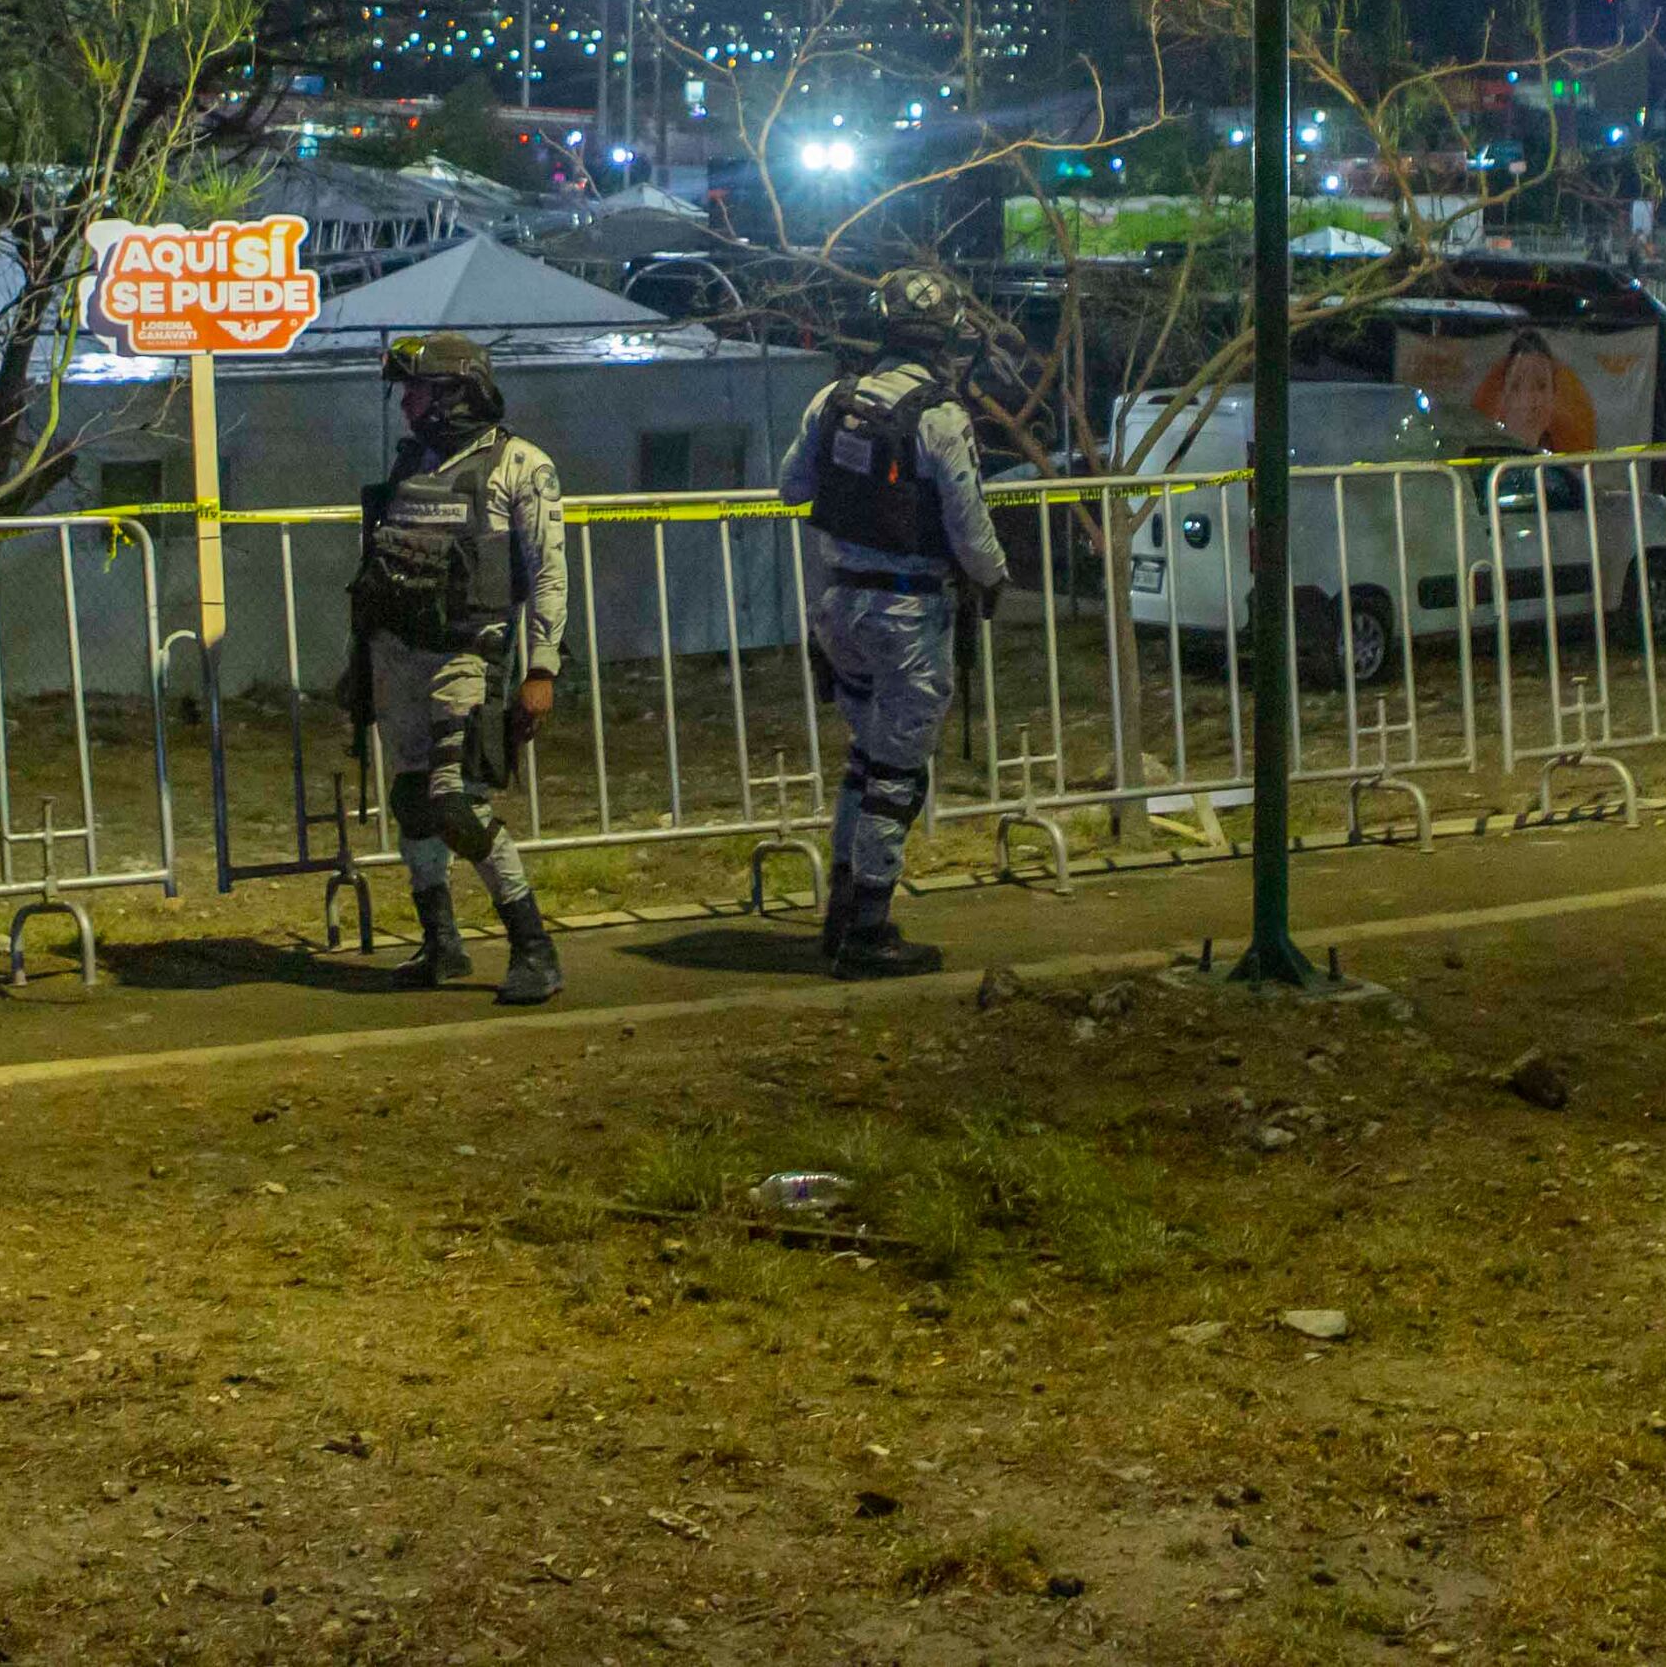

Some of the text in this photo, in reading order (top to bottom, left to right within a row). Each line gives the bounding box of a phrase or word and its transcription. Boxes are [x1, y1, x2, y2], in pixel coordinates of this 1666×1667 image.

[120, 224, 290, 279] AQUÍ SÍ
[112, 280, 310, 314] SE PUEDE
